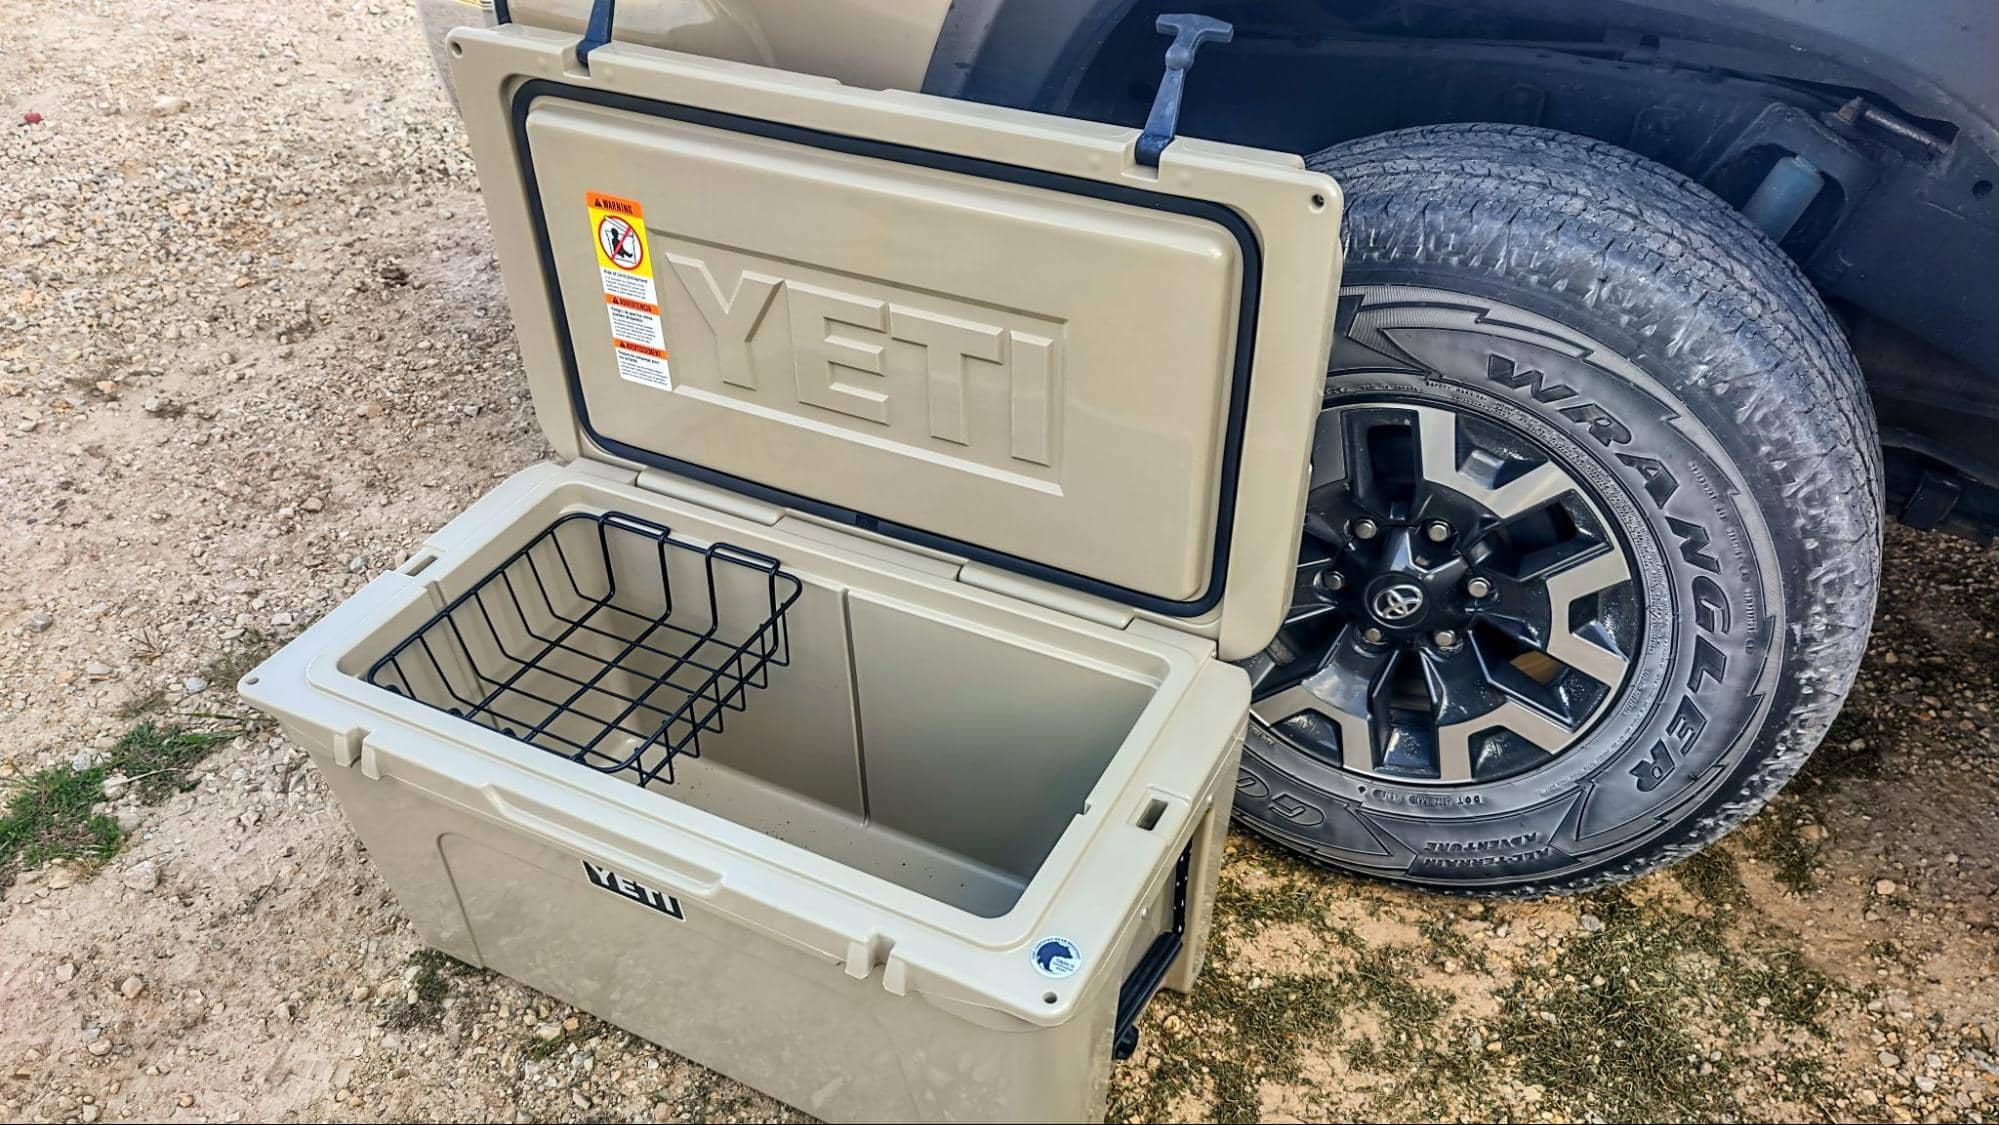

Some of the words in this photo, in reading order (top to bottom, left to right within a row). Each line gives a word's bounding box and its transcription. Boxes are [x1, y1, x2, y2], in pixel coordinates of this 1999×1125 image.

[665, 252, 1054, 468] YETI
[1487, 353, 1732, 793] WRANGLER
[1457, 795, 1482, 805] DOT
[1424, 832, 1537, 852] ADVENTURE
[590, 862, 675, 913] YETI
